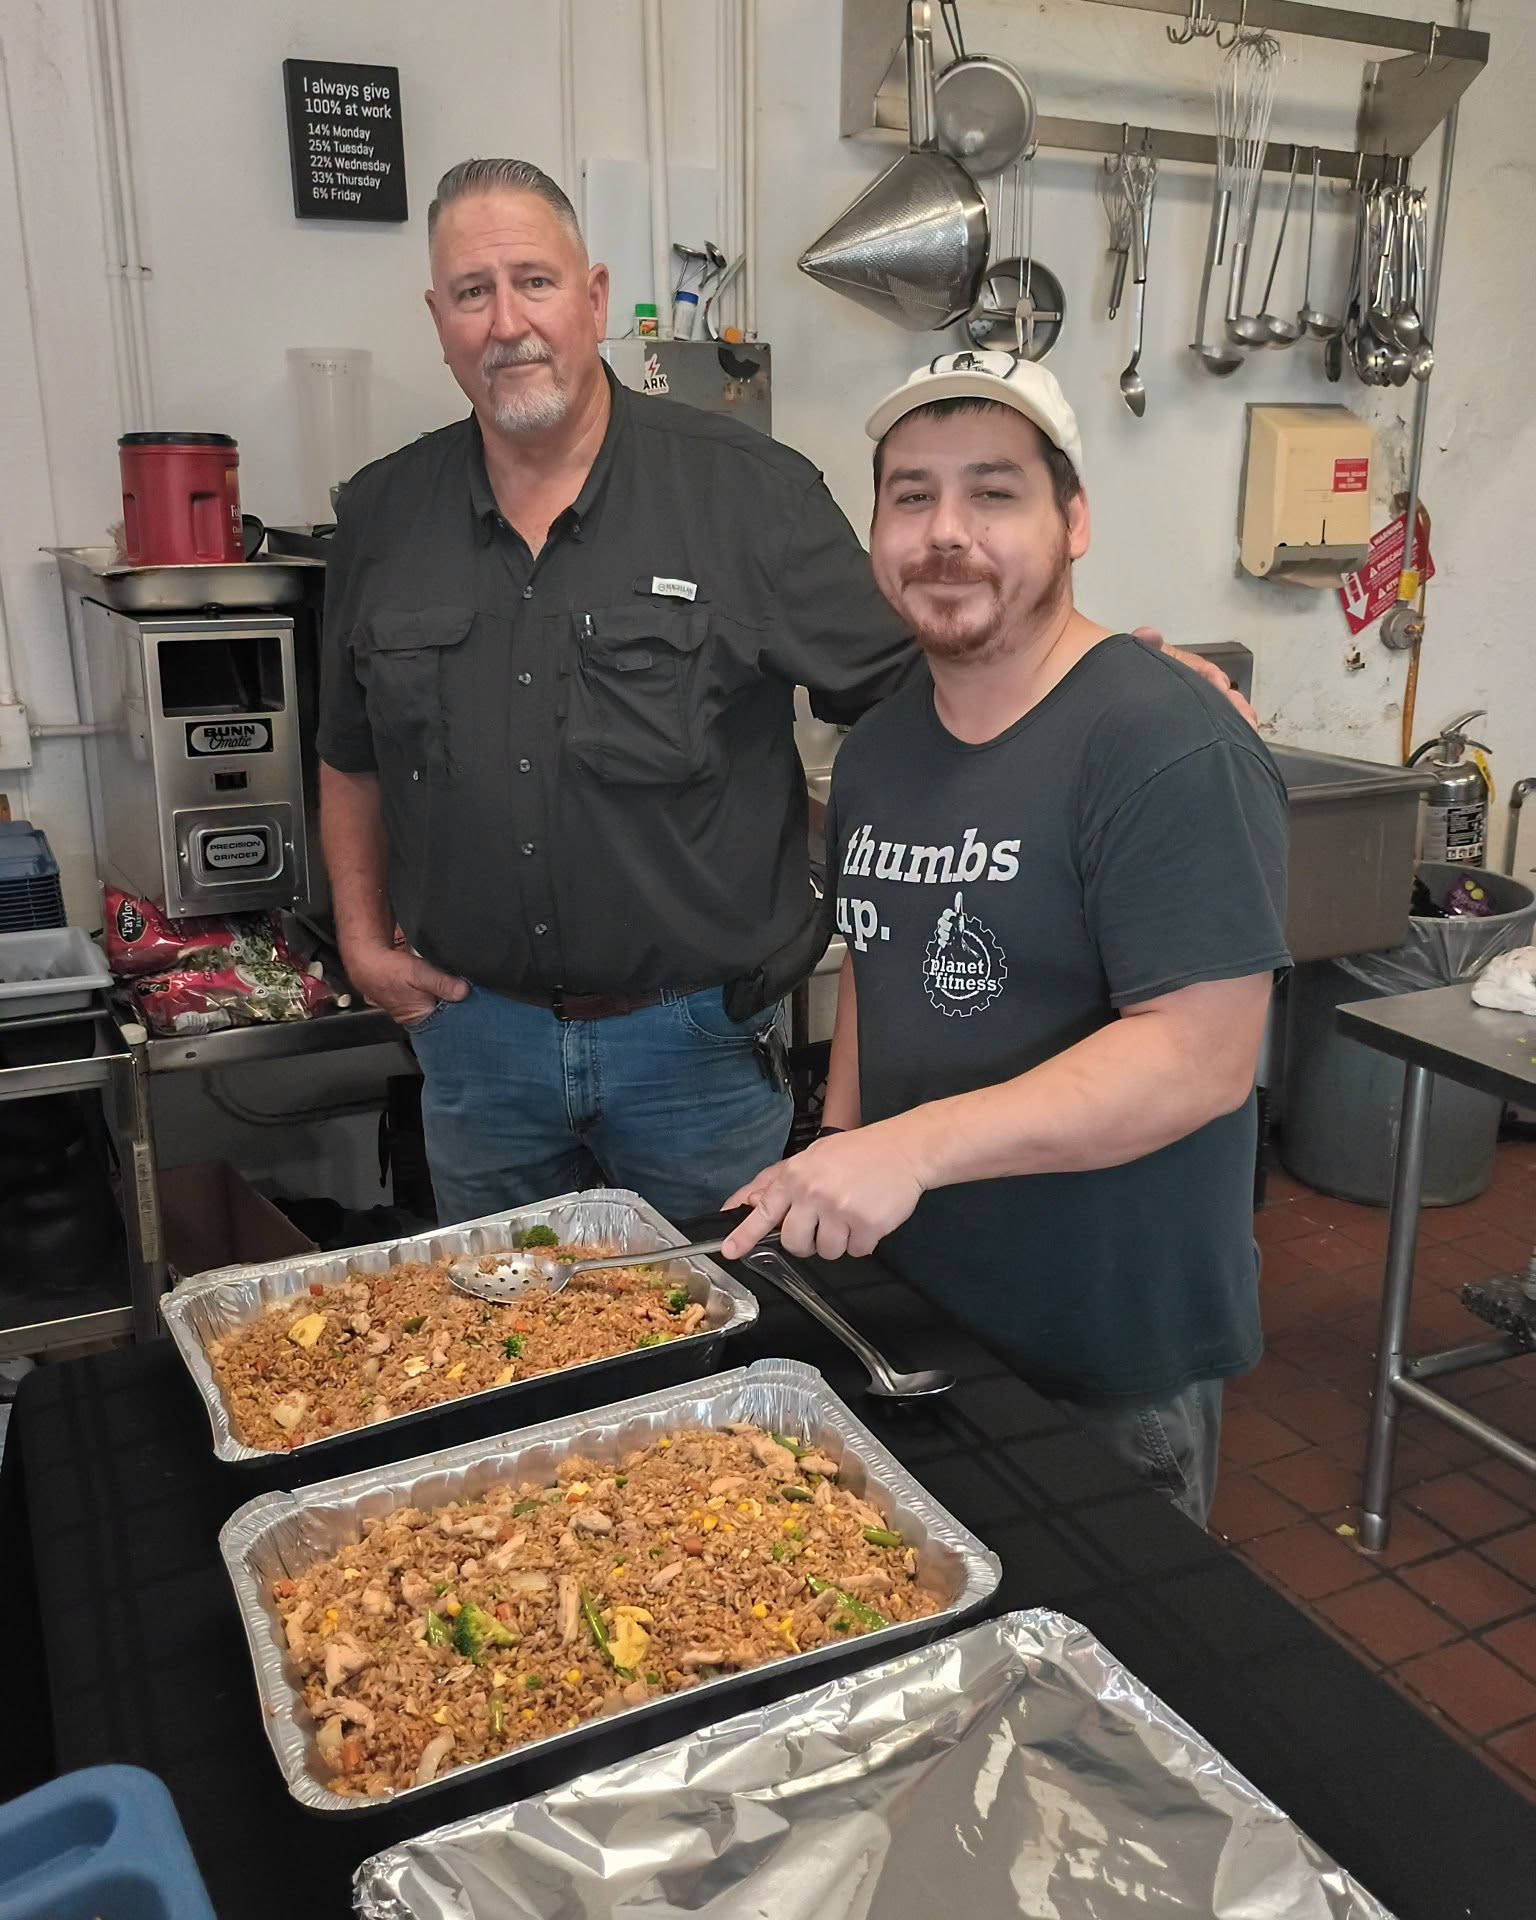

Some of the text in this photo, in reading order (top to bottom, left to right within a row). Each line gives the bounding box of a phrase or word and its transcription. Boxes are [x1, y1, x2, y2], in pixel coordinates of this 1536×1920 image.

[303, 76, 390, 101] I always give
[305, 98, 392, 119] 100% at work
[308, 123, 371, 142] 14% Monday
[308, 139, 374, 158] 25% Tuesday
[310, 155, 391, 175] 22% Wednesday
[311, 171, 380, 189] 33% Thursday
[313, 187, 361, 204] 6% Friday
[1373, 520, 1404, 546] WARNING
[203, 725, 256, 738] BUNN
[210, 841, 261, 851] PRECISION
[842, 825, 1021, 884] thumbs
[213, 852, 258, 861] GRINDER
[122, 900, 135, 937] Taylor
[836, 897, 890, 952] up.
[929, 956, 985, 976] planet
[935, 973, 997, 991] fitness
